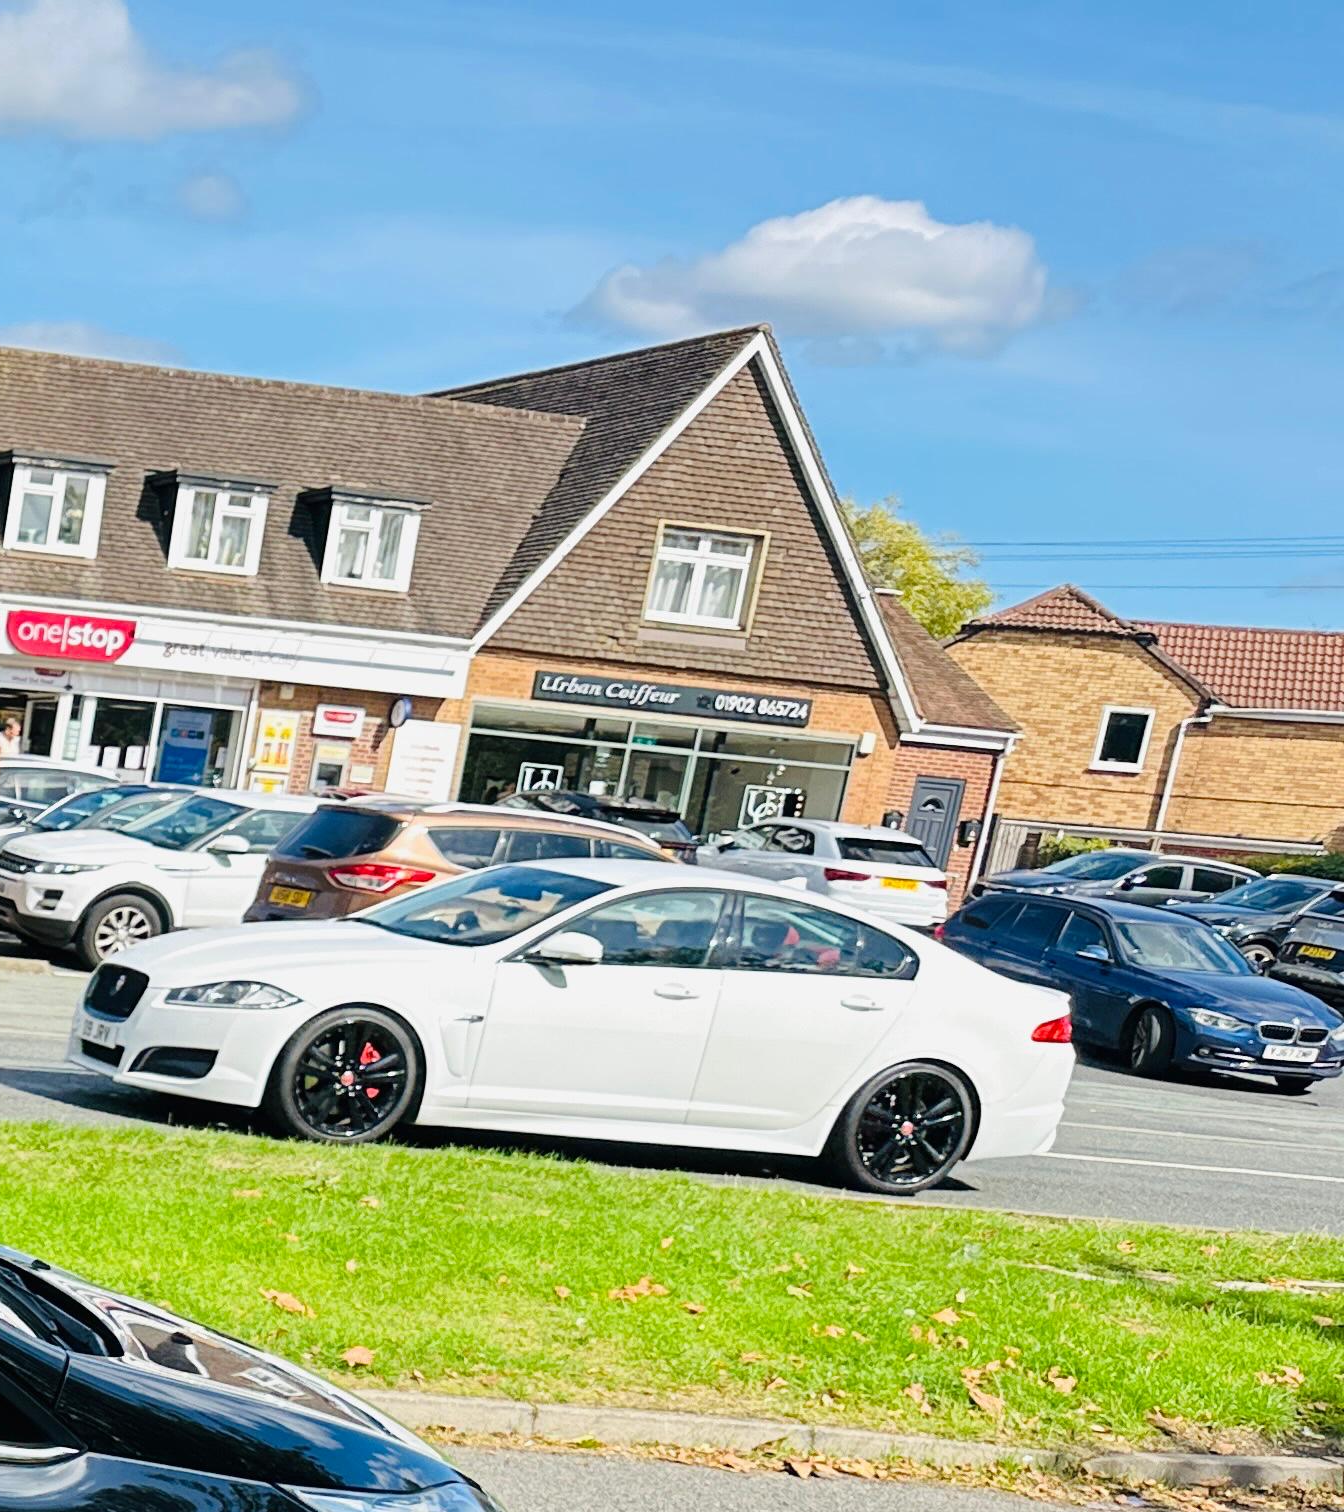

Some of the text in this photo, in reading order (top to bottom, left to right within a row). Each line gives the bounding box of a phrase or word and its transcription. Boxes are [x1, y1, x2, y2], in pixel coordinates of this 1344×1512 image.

[541, 676, 809, 720] Urban Coiffeur 01902 865724
